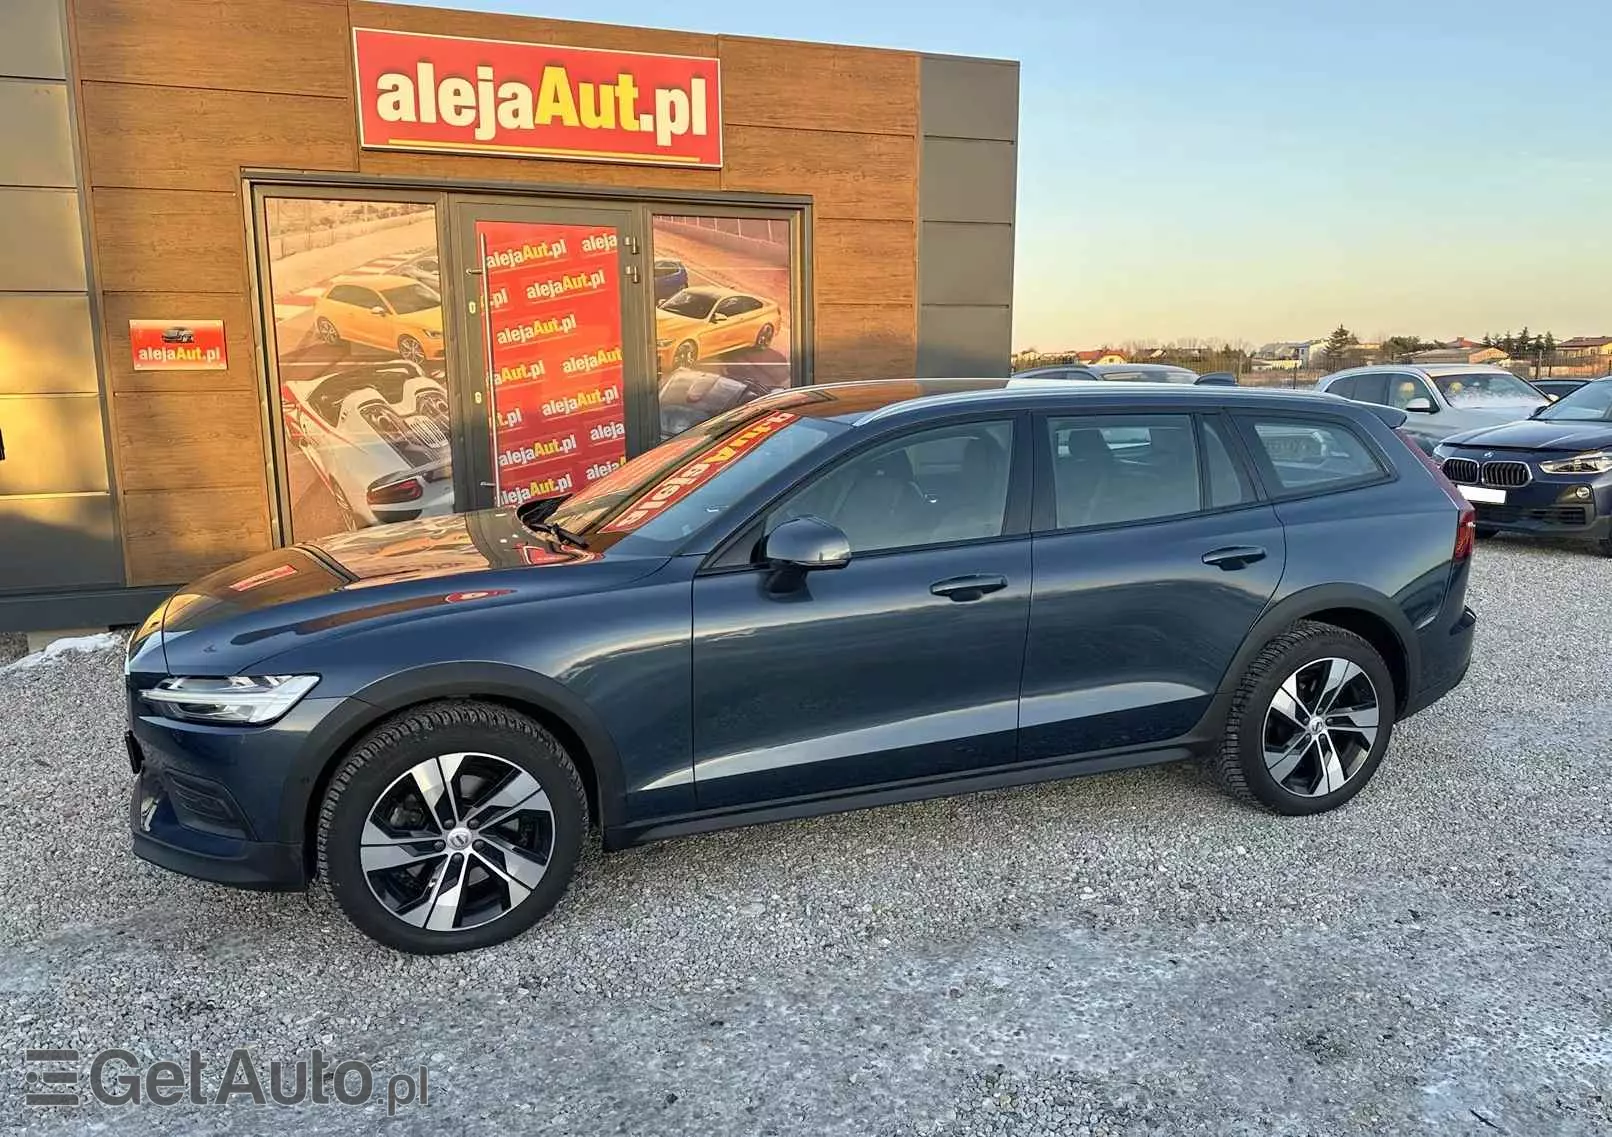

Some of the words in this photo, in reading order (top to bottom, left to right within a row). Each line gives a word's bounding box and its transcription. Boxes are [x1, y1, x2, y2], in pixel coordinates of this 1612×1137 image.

[376, 62, 707, 147] alejaAut.pl
[486, 239, 567, 268] alejaAut.pl
[582, 233, 617, 252] aleja
[526, 269, 606, 299] alejaAut.pl
[497, 314, 576, 344] alejaAut.pl
[139, 346, 220, 362] alejaAut.pl
[542, 385, 619, 416] alejaAut.pl
[590, 422, 625, 441] aleja
[498, 434, 577, 466] alejaAut.pl
